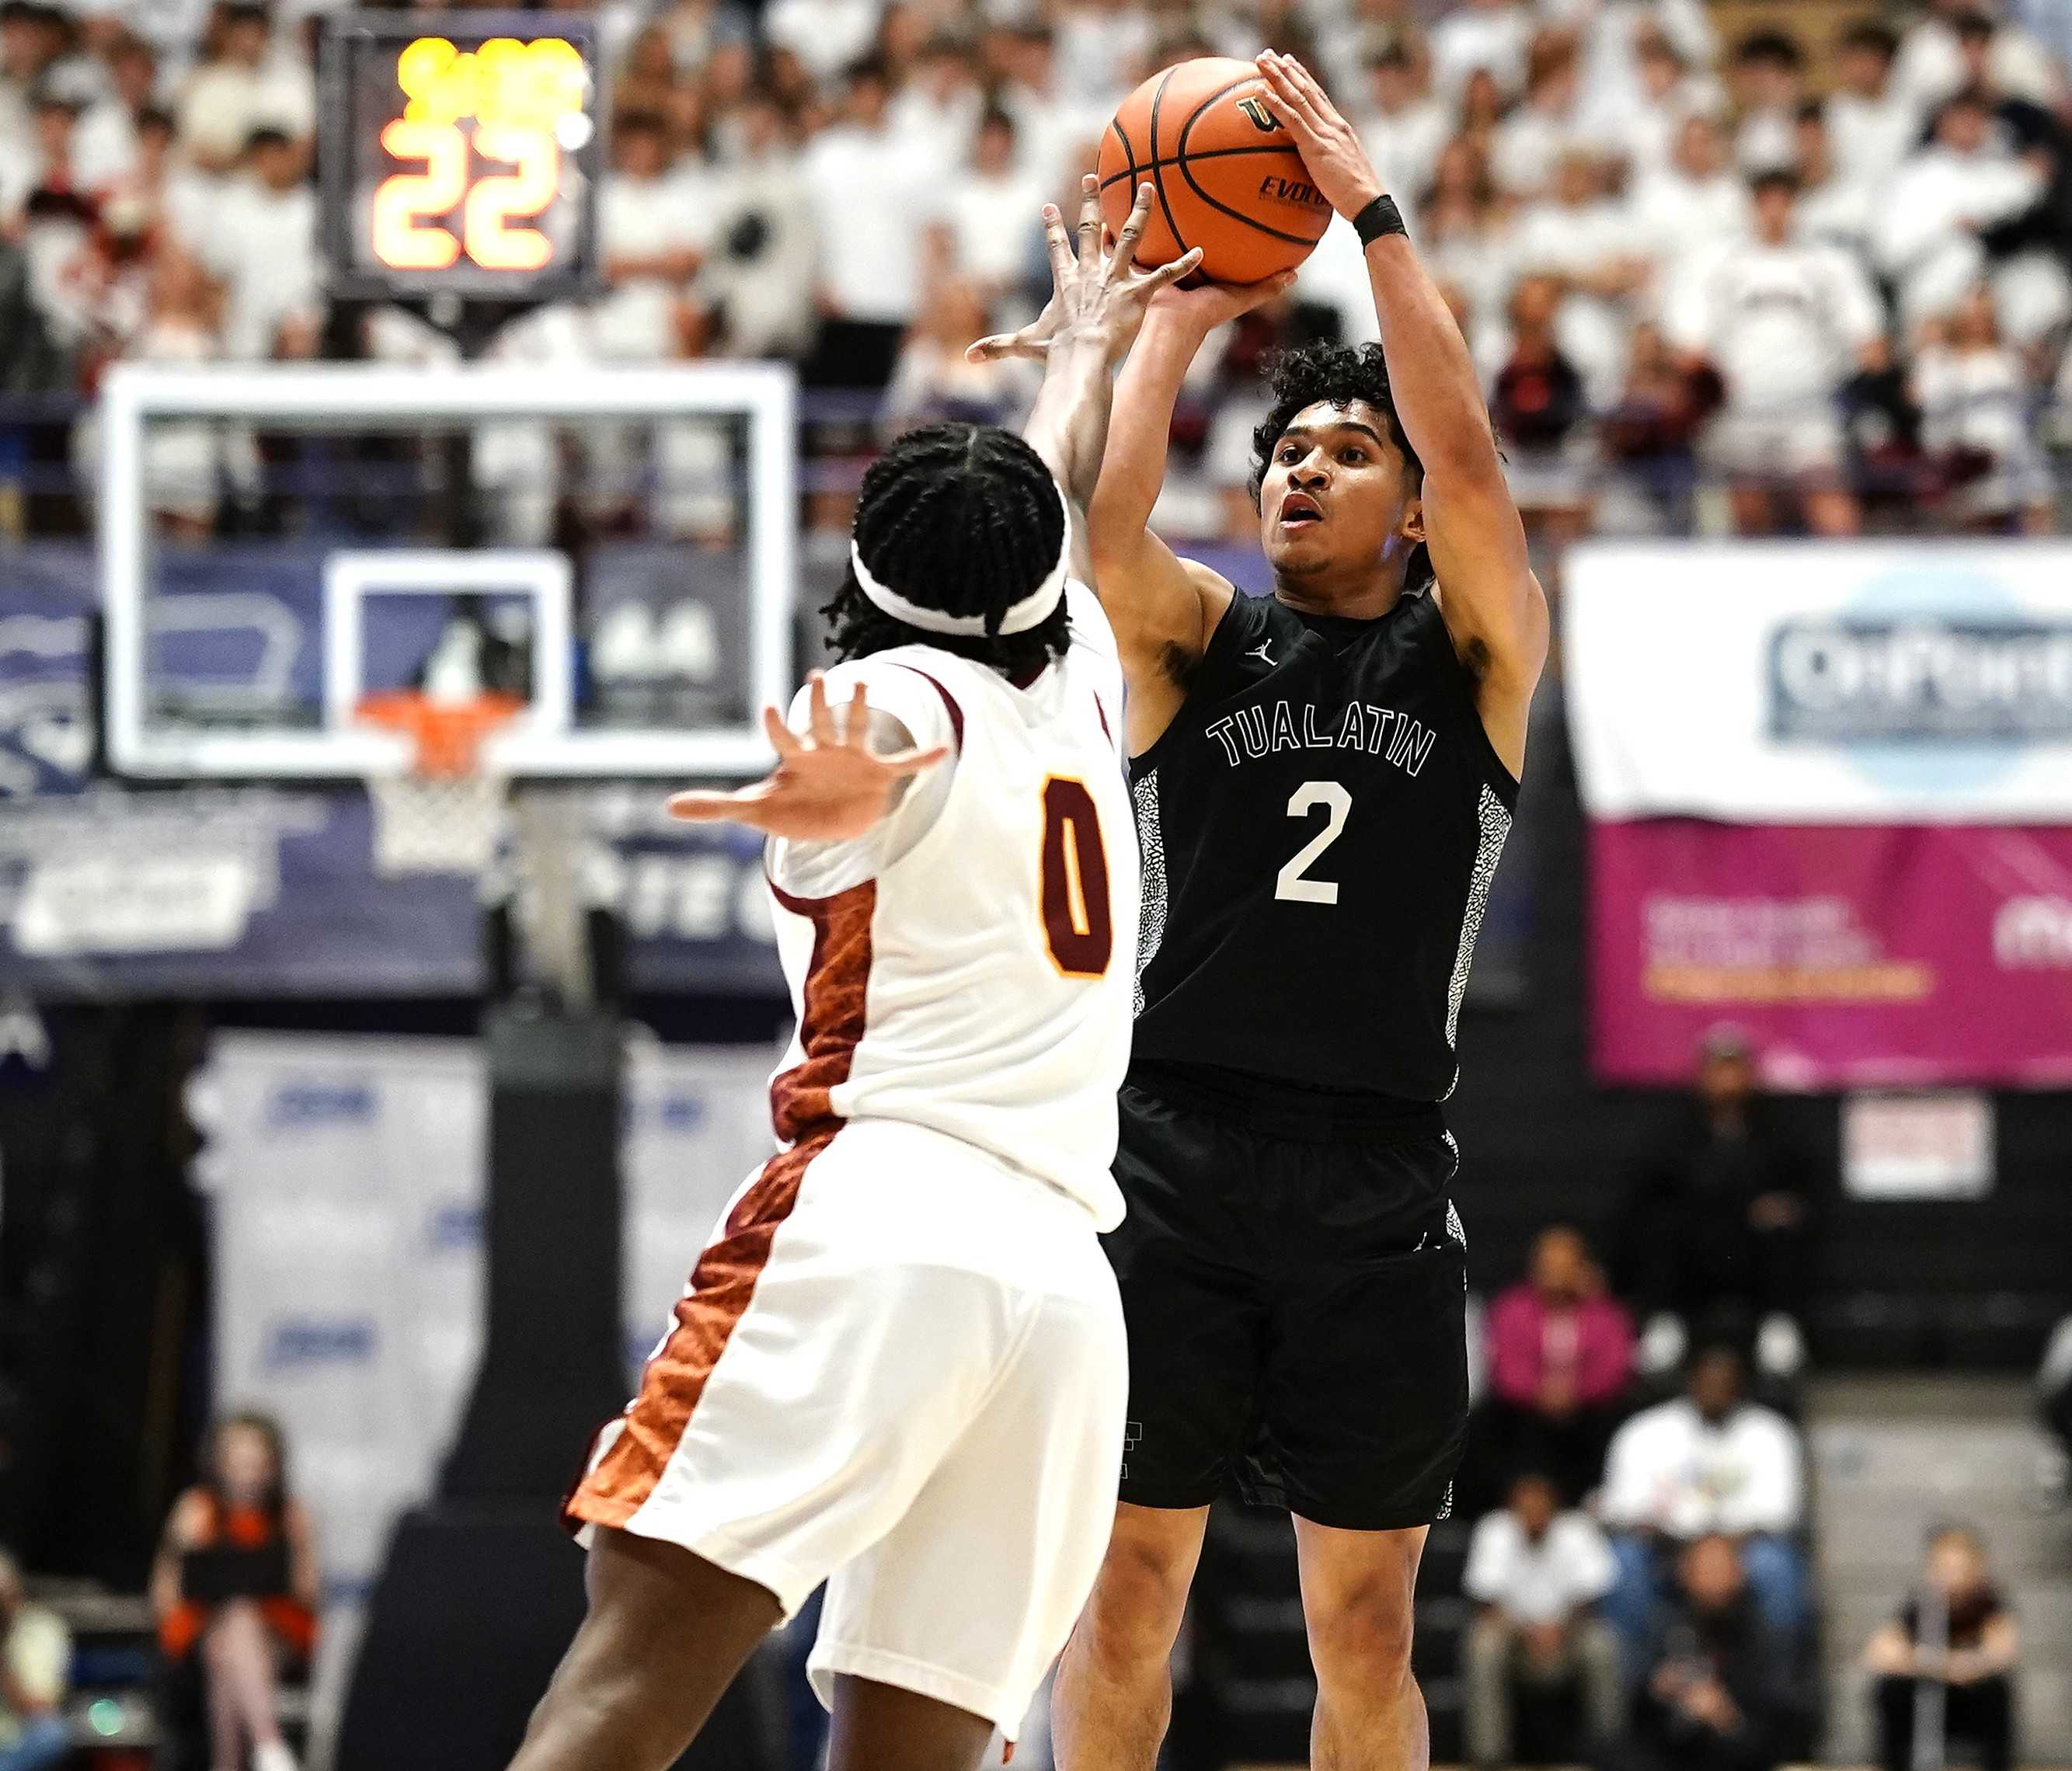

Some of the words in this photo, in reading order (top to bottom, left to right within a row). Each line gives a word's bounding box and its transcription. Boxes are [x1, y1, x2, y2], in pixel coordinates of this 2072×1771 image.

[373, 118, 559, 270] 22
[1205, 701, 1436, 777] TUALATIN
[1039, 772, 1113, 980] 0
[1274, 781, 1353, 905] 2
